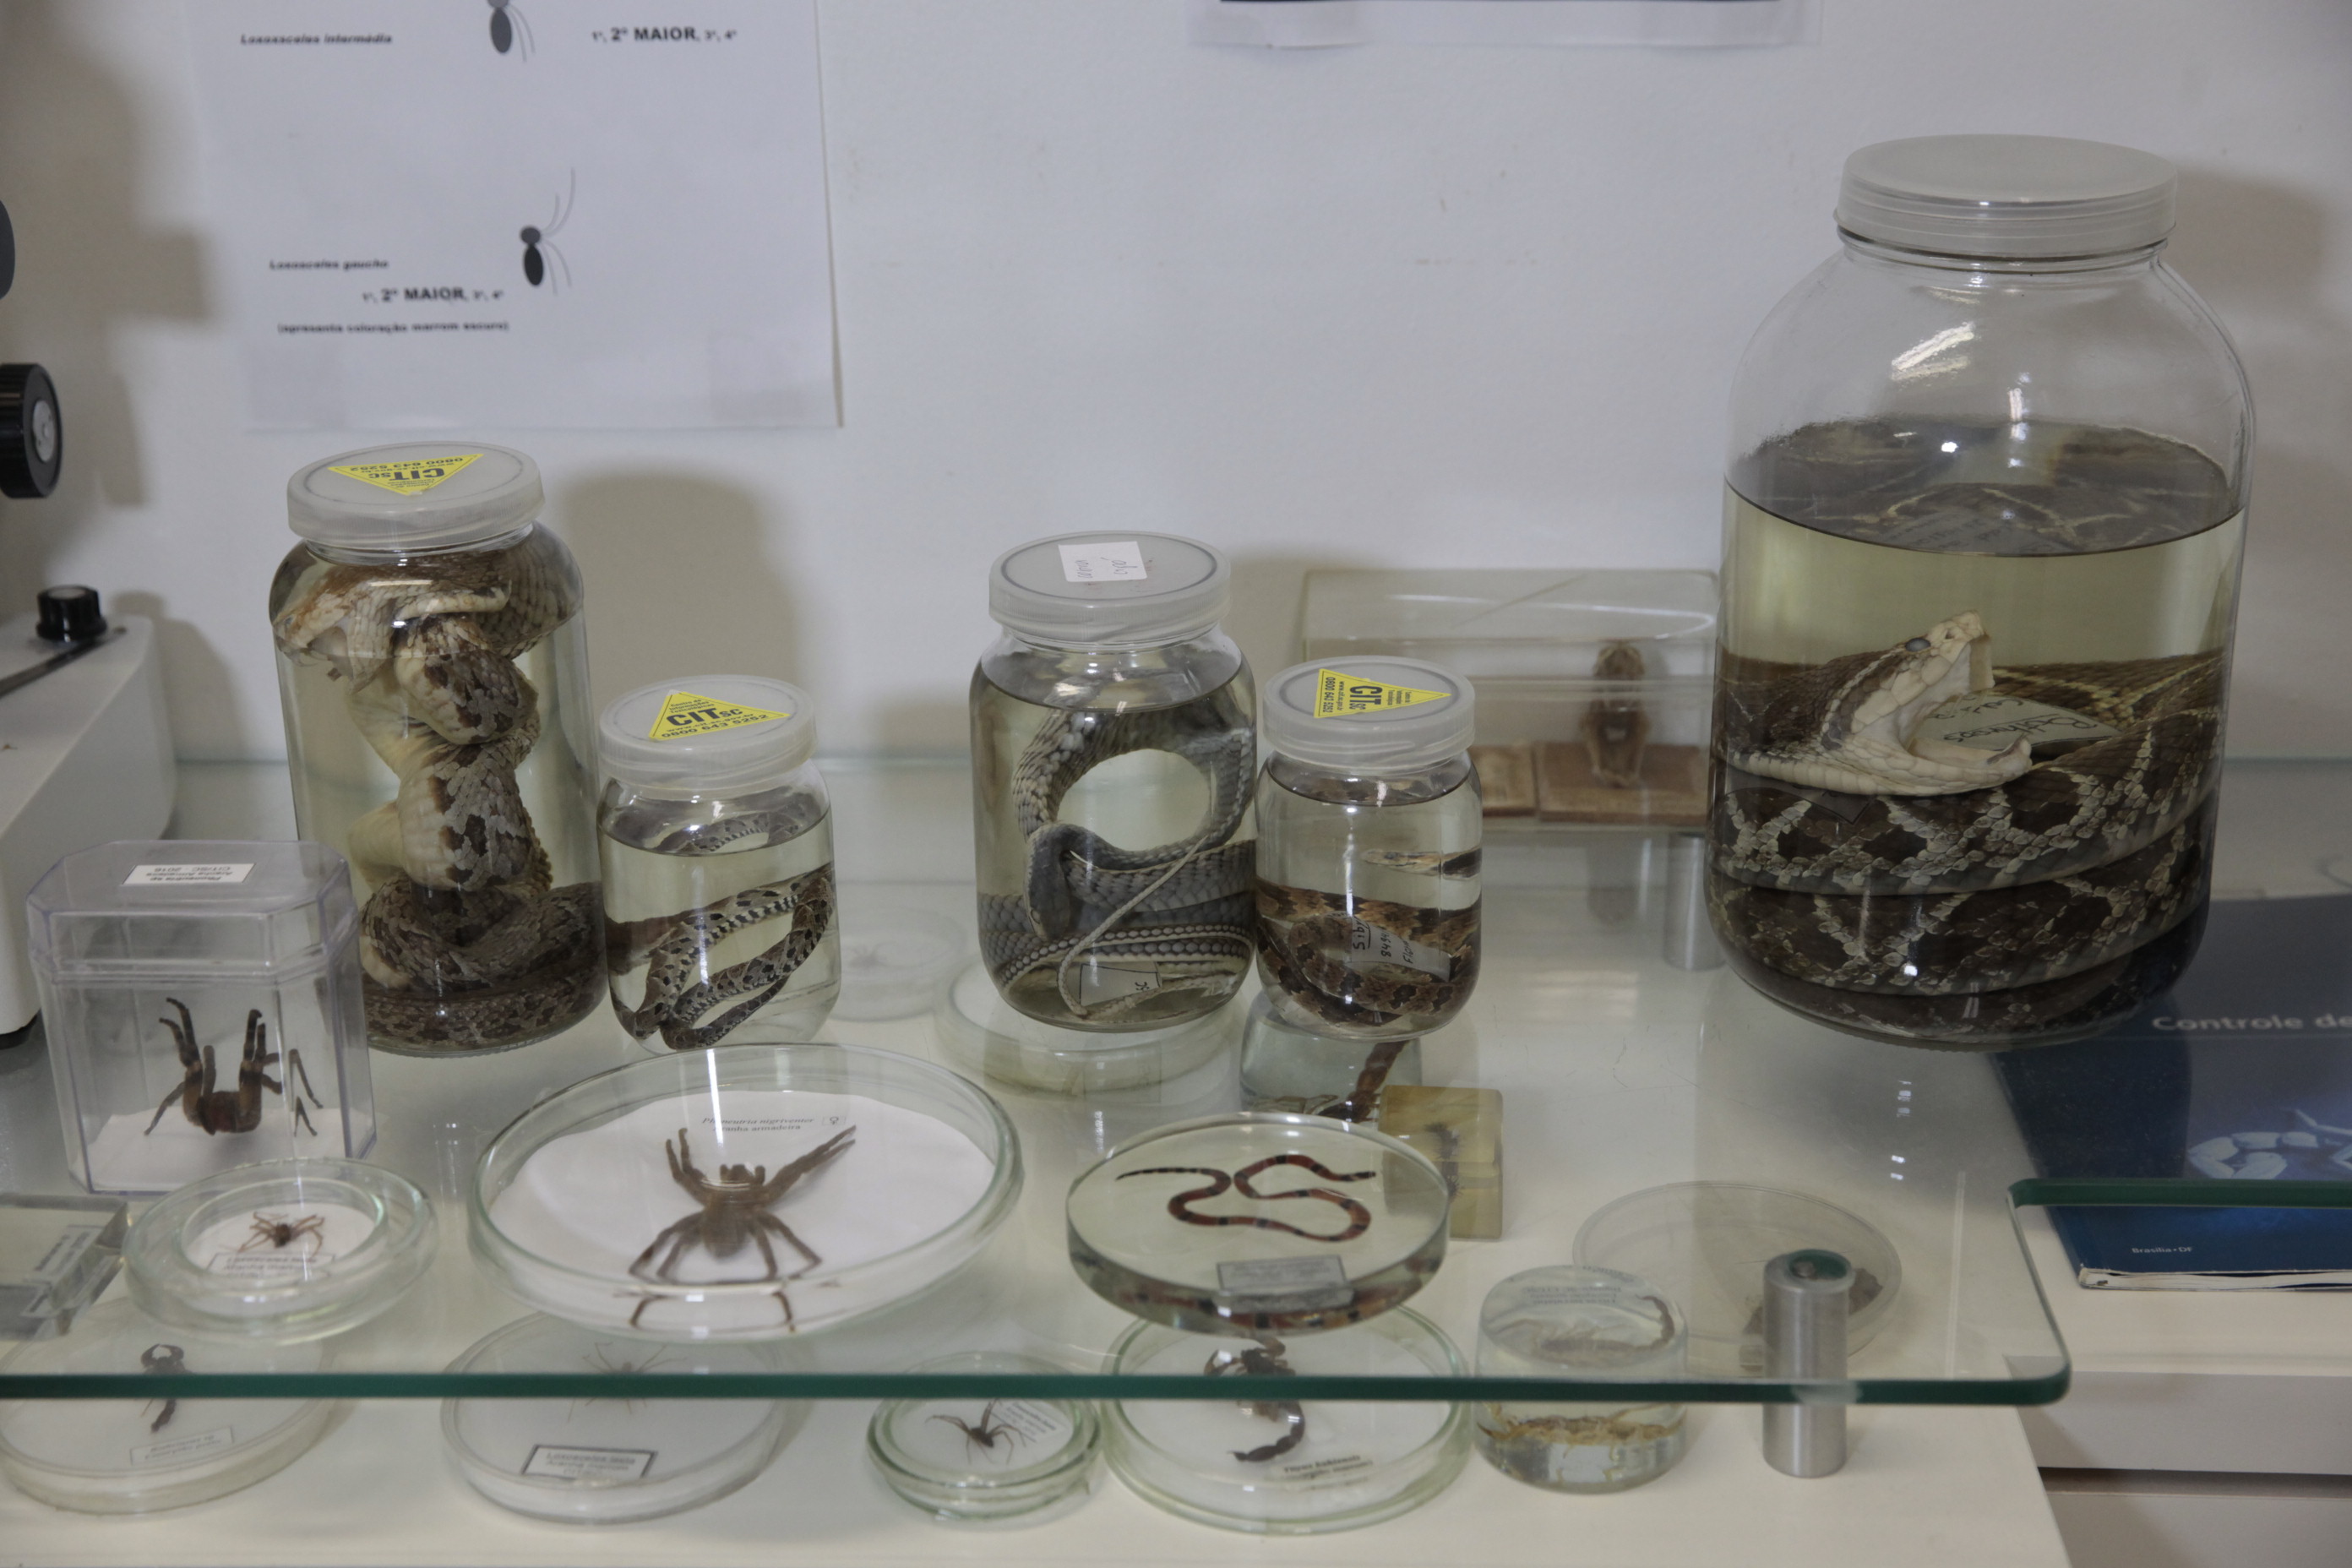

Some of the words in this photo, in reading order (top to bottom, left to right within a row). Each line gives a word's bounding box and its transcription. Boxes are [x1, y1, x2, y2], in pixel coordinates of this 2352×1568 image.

[426, 456, 464, 466] 0800
[349, 464, 389, 472] 5252
[1324, 676, 1337, 691] 0800
[1324, 691, 1335, 701] 643
[1321, 701, 1334, 713] 5252
[662, 728, 698, 738] 0800
[701, 722, 729, 732] 643
[732, 714, 770, 725] 5252
[2152, 1014, 2305, 1031] Controle
[2314, 1012, 2352, 1030] de
